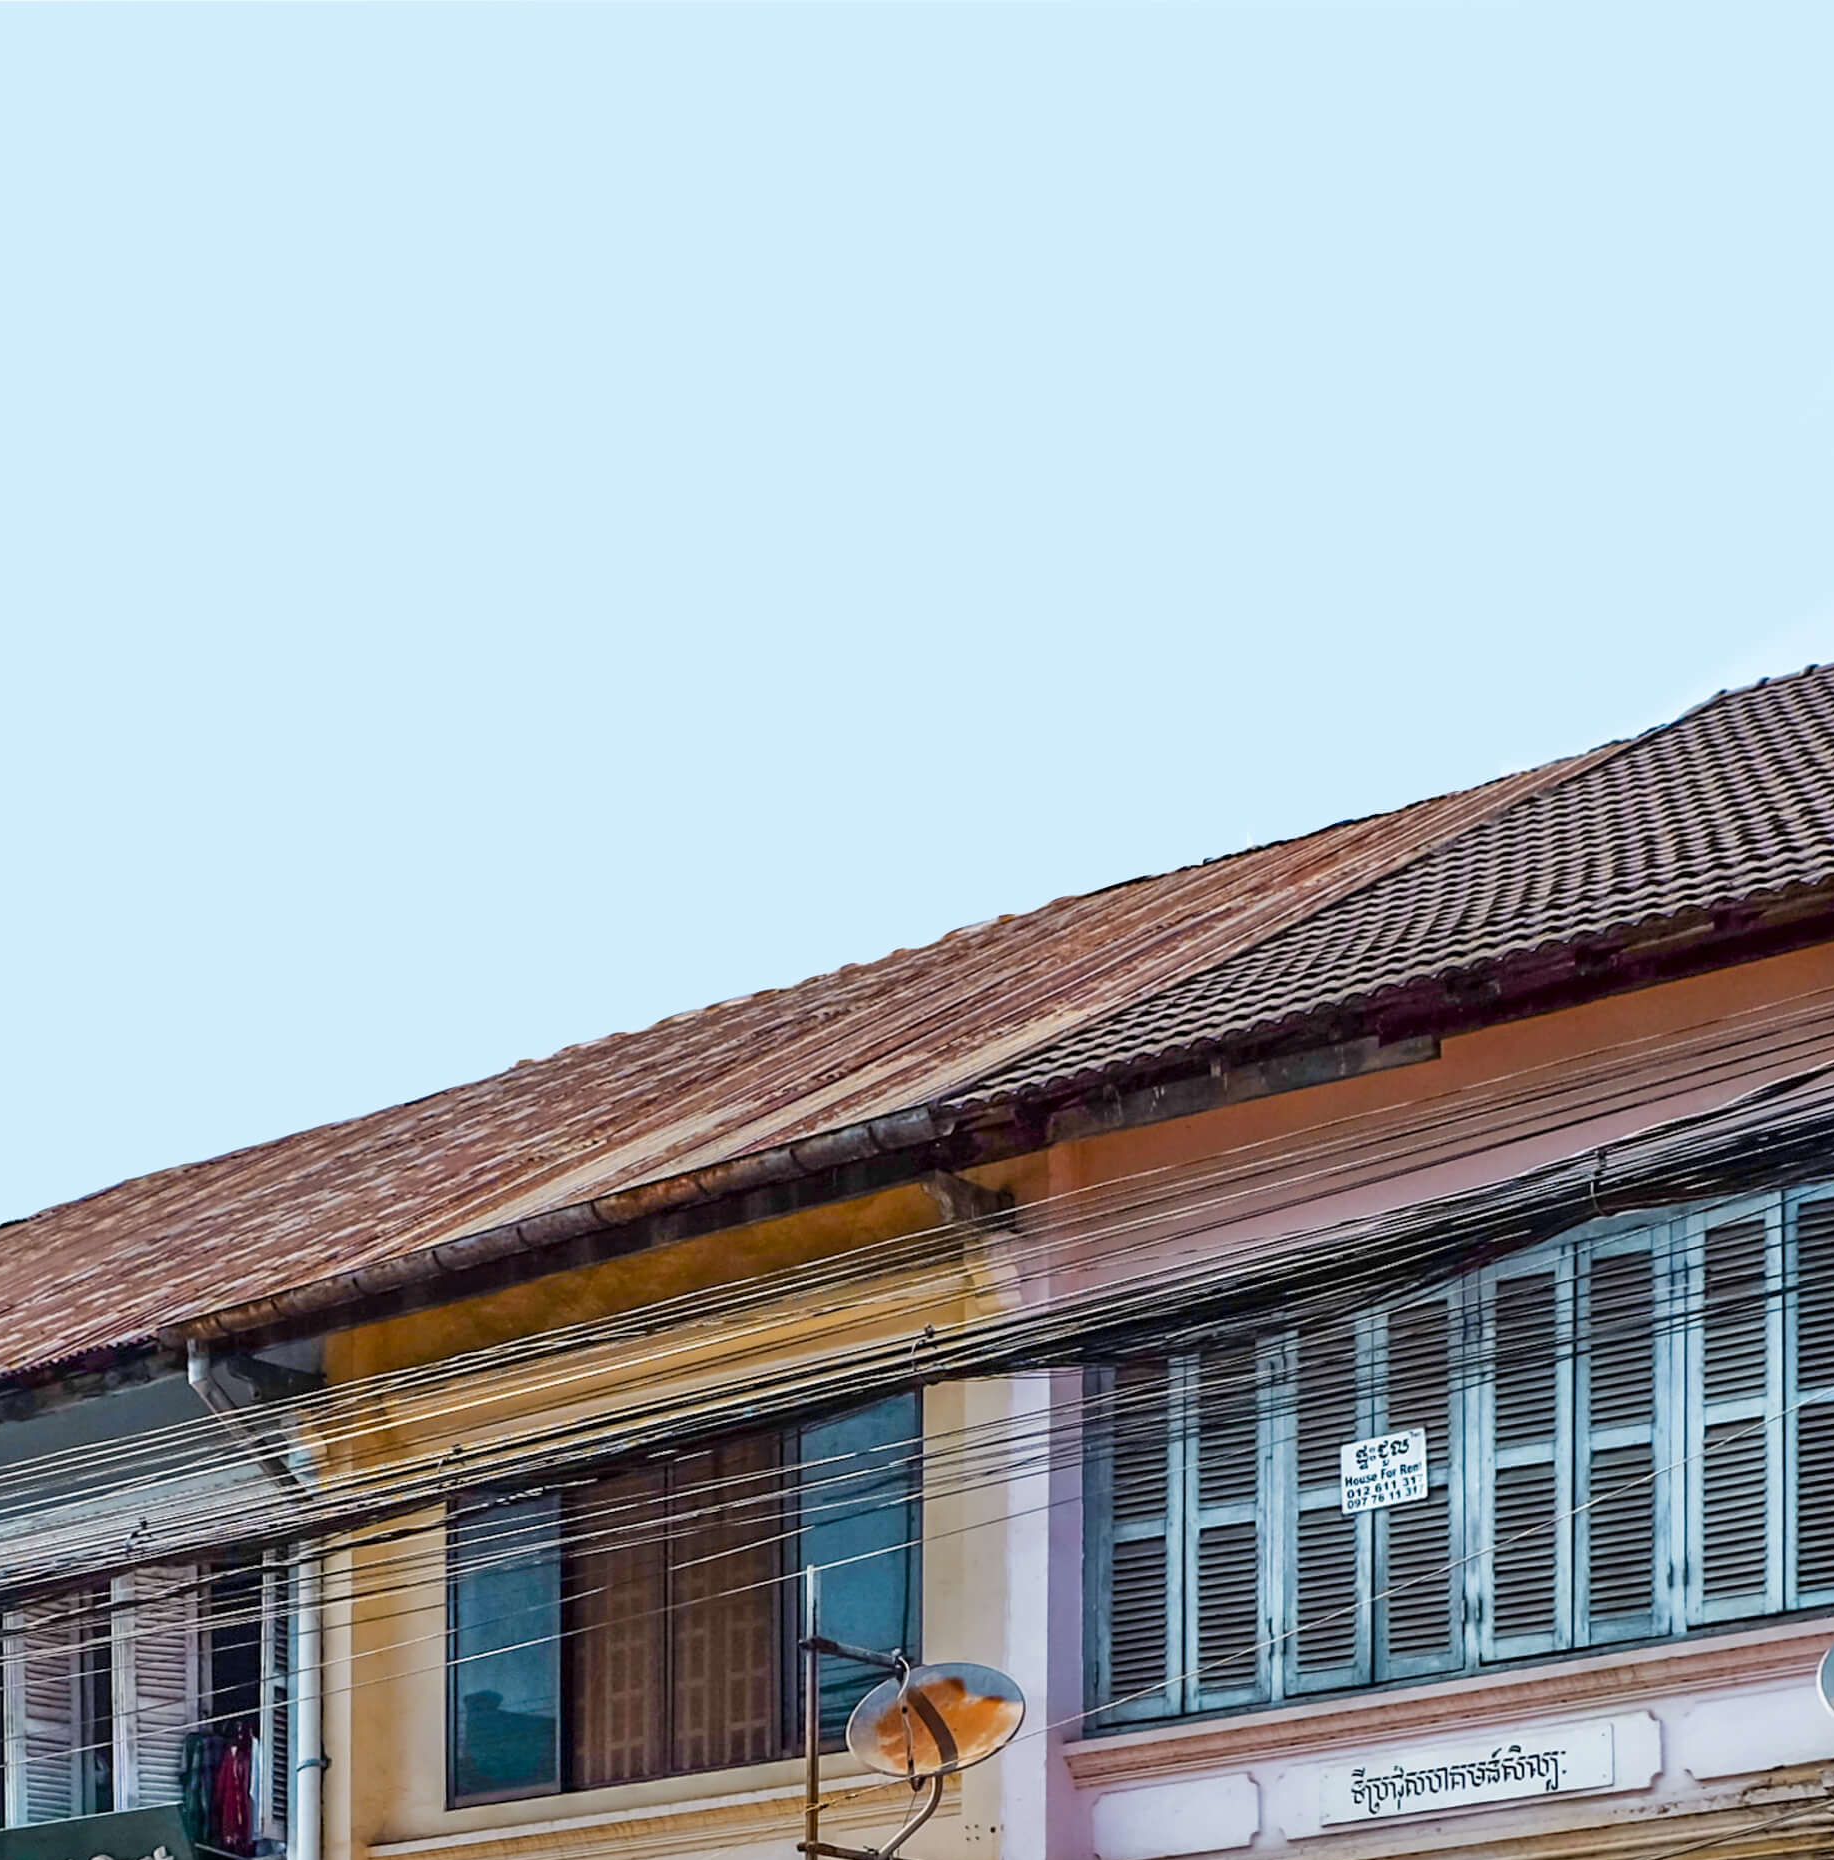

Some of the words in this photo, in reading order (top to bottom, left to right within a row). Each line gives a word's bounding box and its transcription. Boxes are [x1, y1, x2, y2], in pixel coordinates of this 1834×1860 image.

[1345, 1474, 1378, 1487] House
[1380, 1468, 1397, 1480] For
[1347, 1486, 1370, 1499] 012
[1375, 1480, 1397, 1493] 611
[1347, 1497, 1368, 1510] 097
[1371, 1493, 1385, 1504] 76
[1389, 1489, 1402, 1500] 11
